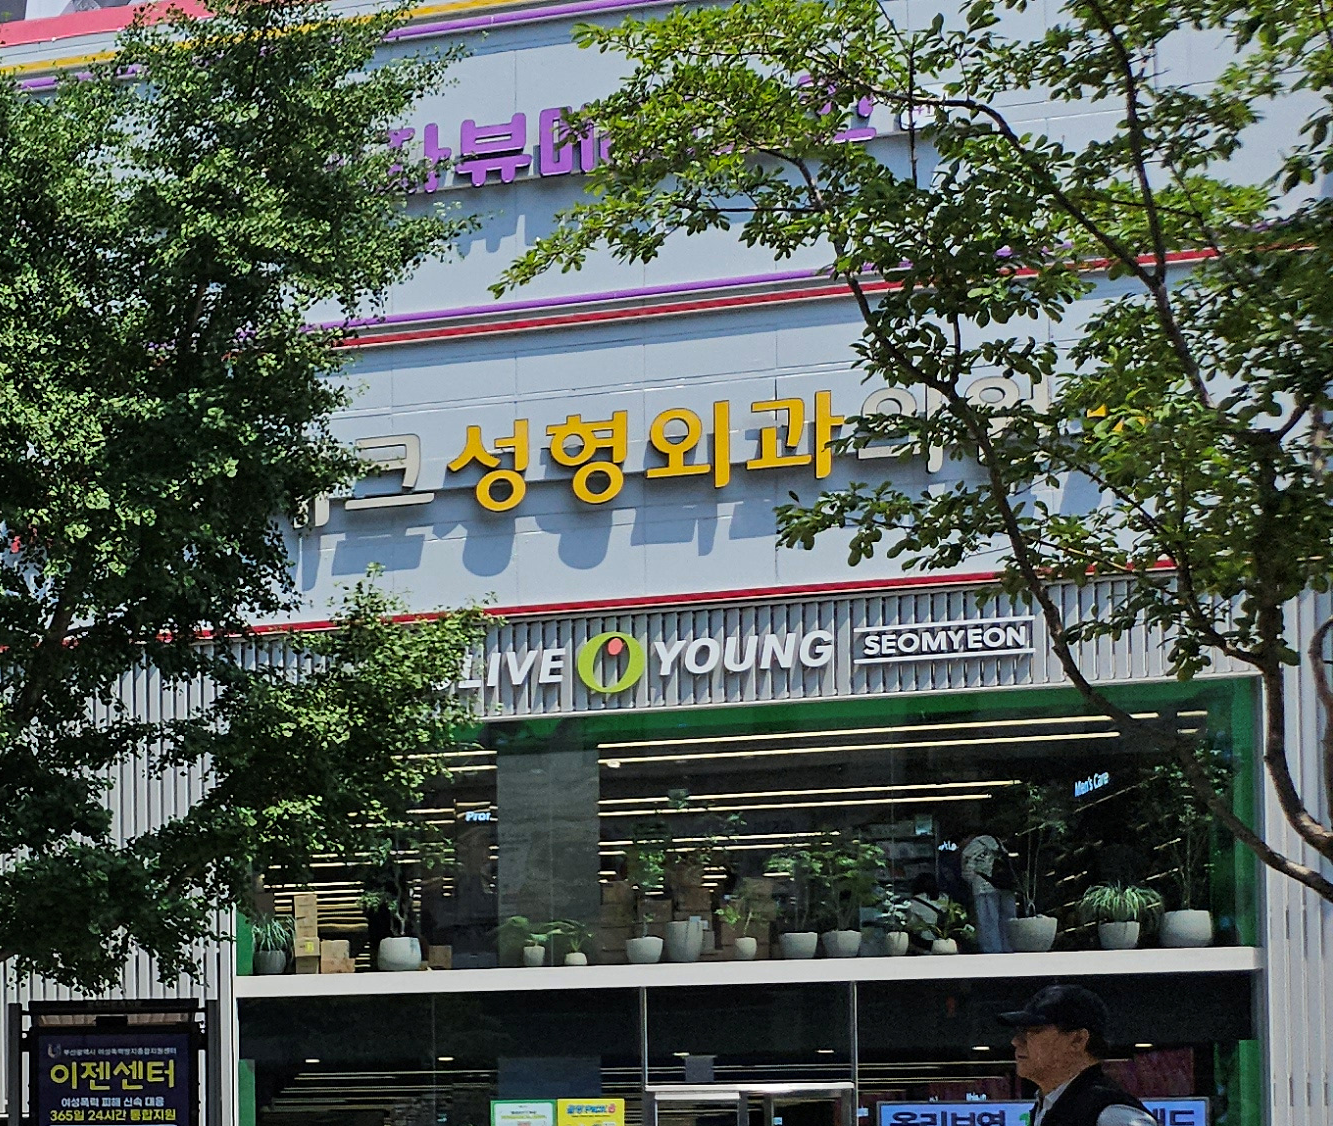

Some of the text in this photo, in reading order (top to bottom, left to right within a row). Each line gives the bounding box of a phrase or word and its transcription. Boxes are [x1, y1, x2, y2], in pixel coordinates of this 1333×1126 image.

[433, 625, 1027, 692] LIVE YOUNG SEOMYEON
[50, 1059, 175, 1091] 이젠센터
[50, 1110, 85, 1121] 365일
[87, 1110, 127, 1121] 24시간
